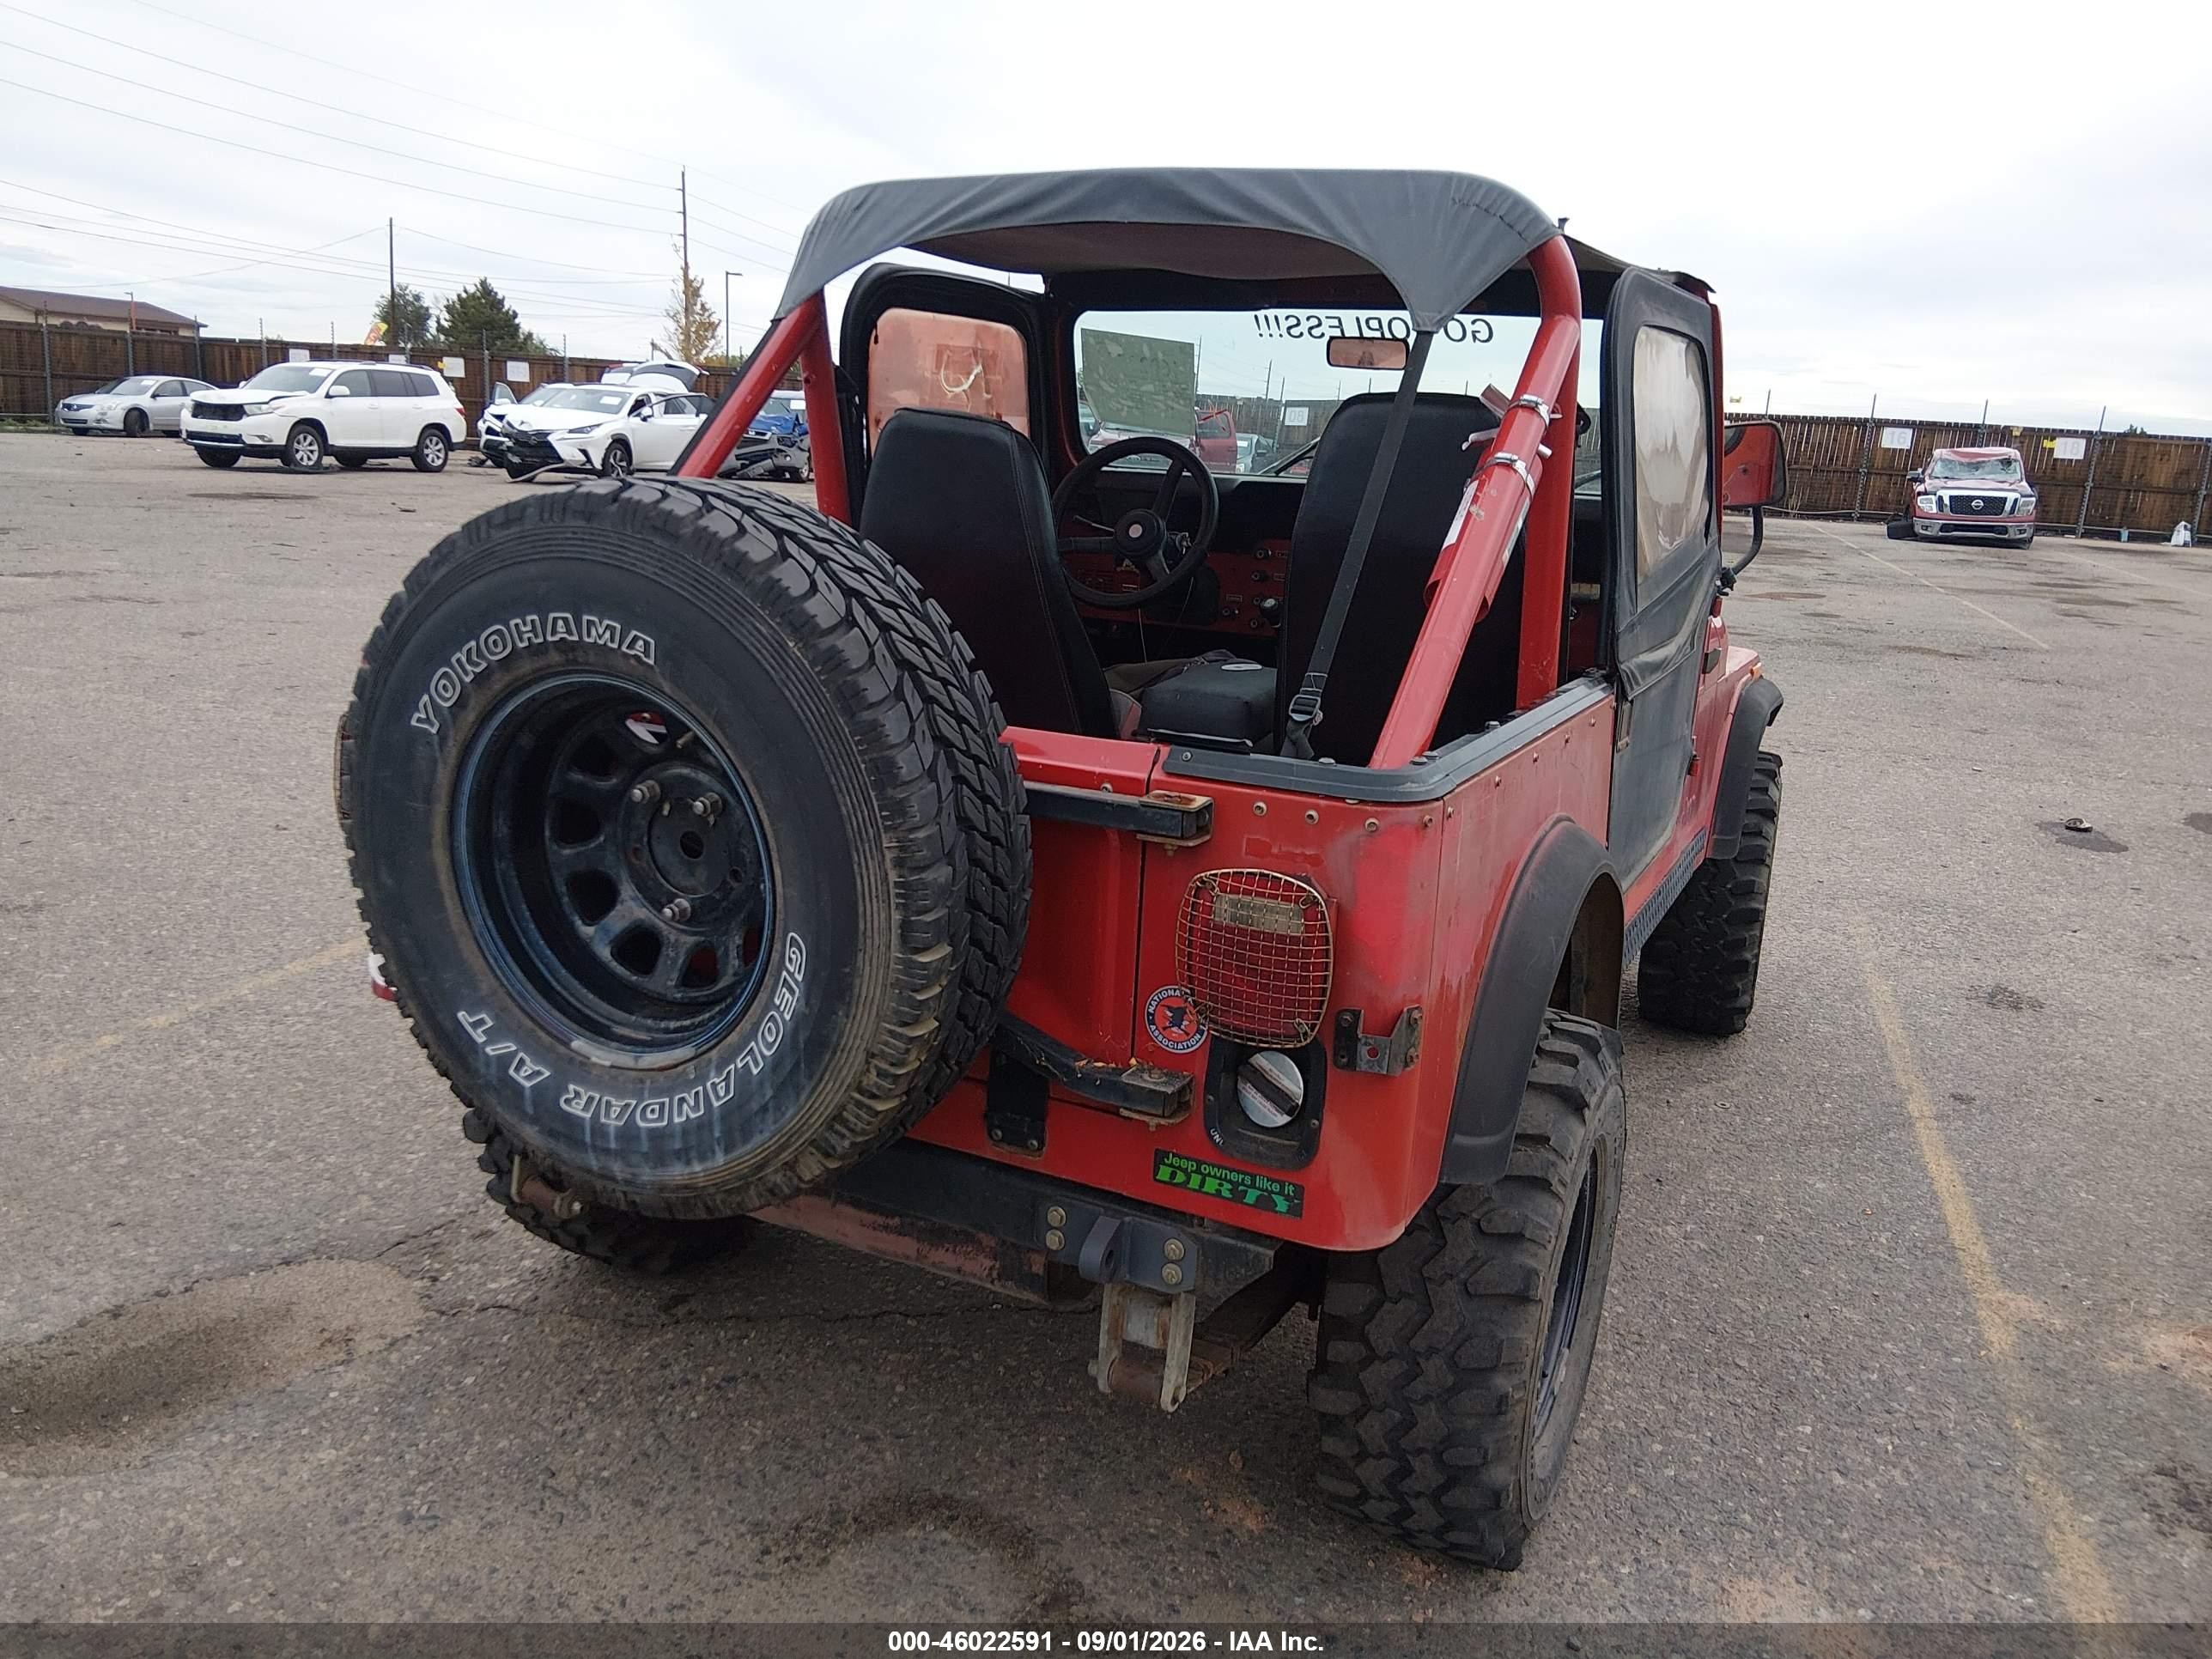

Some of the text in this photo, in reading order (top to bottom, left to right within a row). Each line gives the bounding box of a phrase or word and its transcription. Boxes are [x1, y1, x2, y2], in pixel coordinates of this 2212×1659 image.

[1888, 431, 1907, 446] 16
[2060, 440, 2080, 455] 18
[410, 612, 657, 734] YOKOHAMA
[1147, 988, 1183, 1013] NATIONA
[456, 930, 808, 1127] GEOLANDAR A/T
[1149, 1024, 1202, 1049] ASSOCIATION
[1156, 1164, 1297, 1213] DIRTY
[1164, 1153, 1295, 1196] Jeep owners like it
